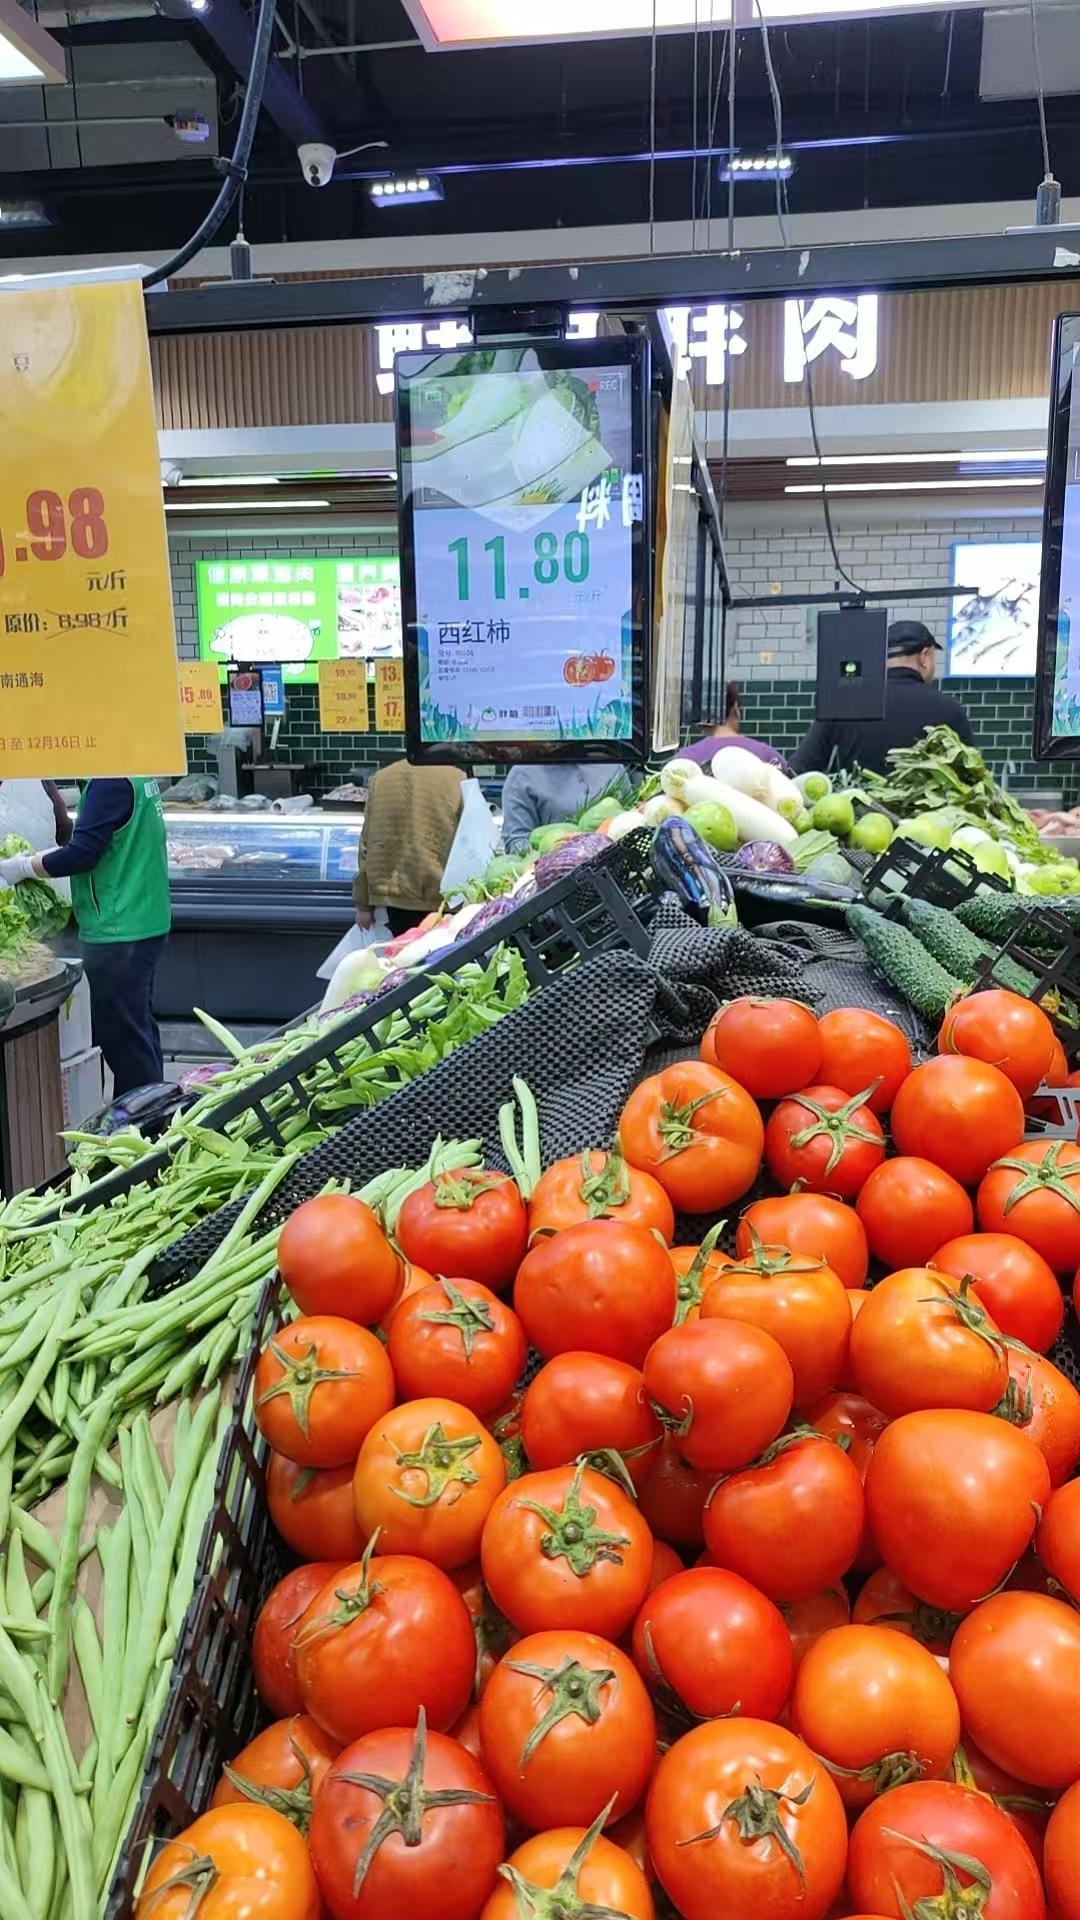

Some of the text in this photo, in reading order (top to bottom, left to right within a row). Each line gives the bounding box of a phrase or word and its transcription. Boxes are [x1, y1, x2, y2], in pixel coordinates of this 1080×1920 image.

[600, 380, 617, 391] REC
[0, 487, 109, 577] .98
[448, 530, 590, 601] 11.80
[86, 570, 127, 591] 元/斤
[437, 619, 510, 645] 西红柿
[0, 672, 44, 688] 南通海
[28, 736, 80, 750] 12月16日
